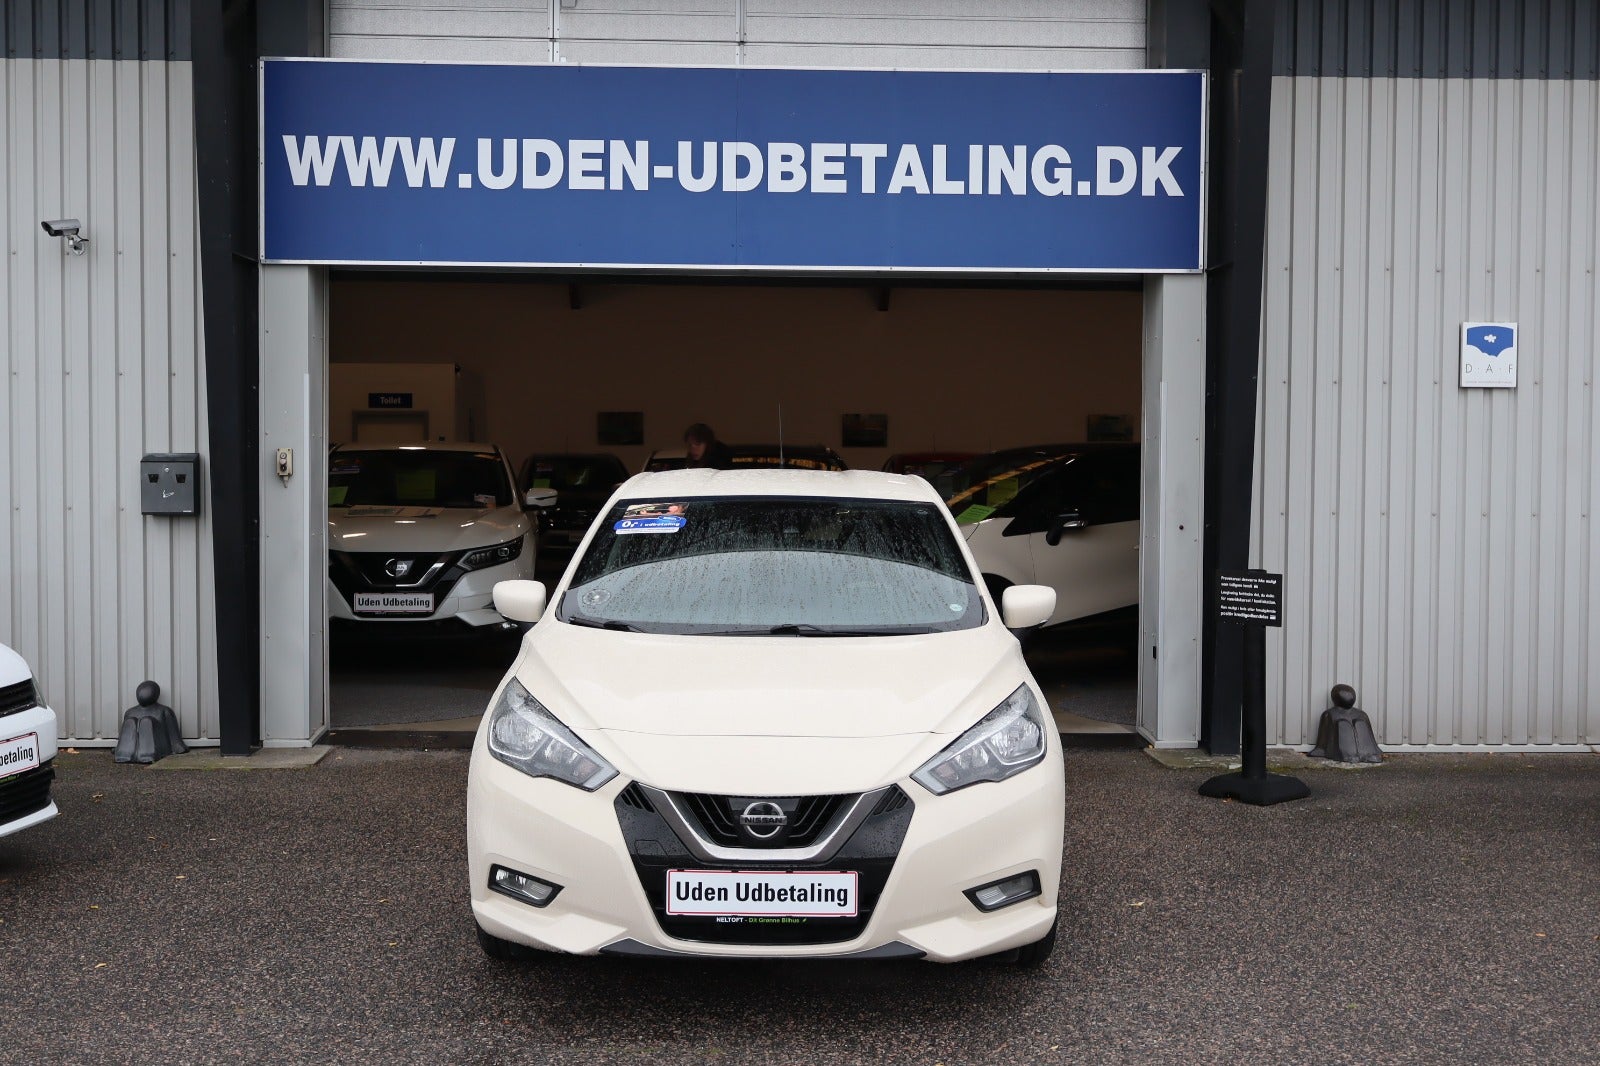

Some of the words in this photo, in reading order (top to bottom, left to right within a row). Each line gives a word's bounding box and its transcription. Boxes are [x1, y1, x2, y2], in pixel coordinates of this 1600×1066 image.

[282, 134, 1184, 197] WWW.UDEN-UDBETALING.DK
[358, 598, 380, 606] Uden
[383, 597, 430, 608] Udbetaling
[676, 881, 728, 901] Uden
[736, 882, 848, 907] Udbetaling
